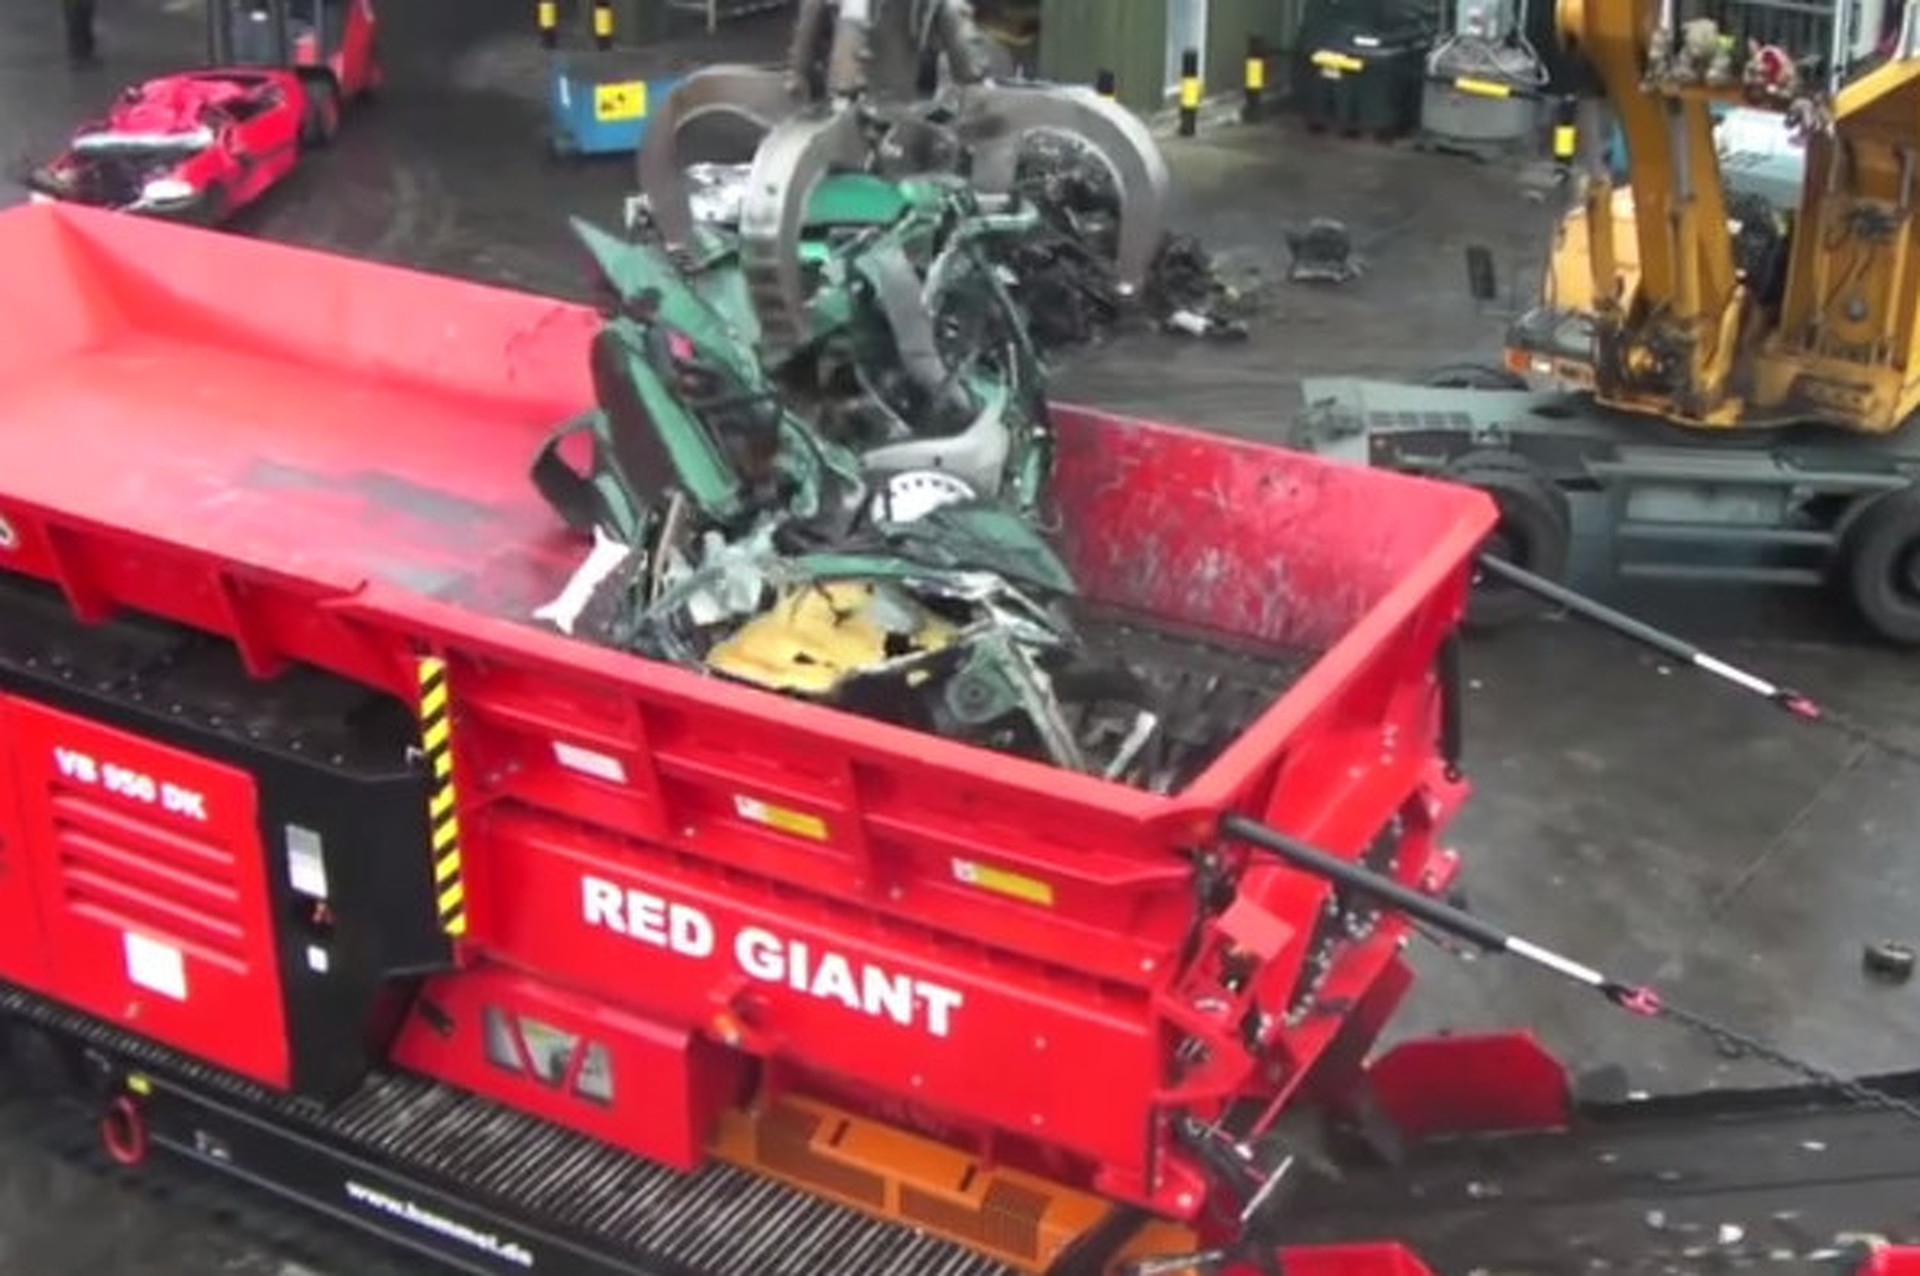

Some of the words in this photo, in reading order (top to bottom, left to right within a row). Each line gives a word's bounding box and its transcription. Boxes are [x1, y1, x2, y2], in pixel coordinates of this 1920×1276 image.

[161, 783, 207, 820] DK
[582, 875, 715, 958] RED
[734, 926, 962, 1037] GIANT
